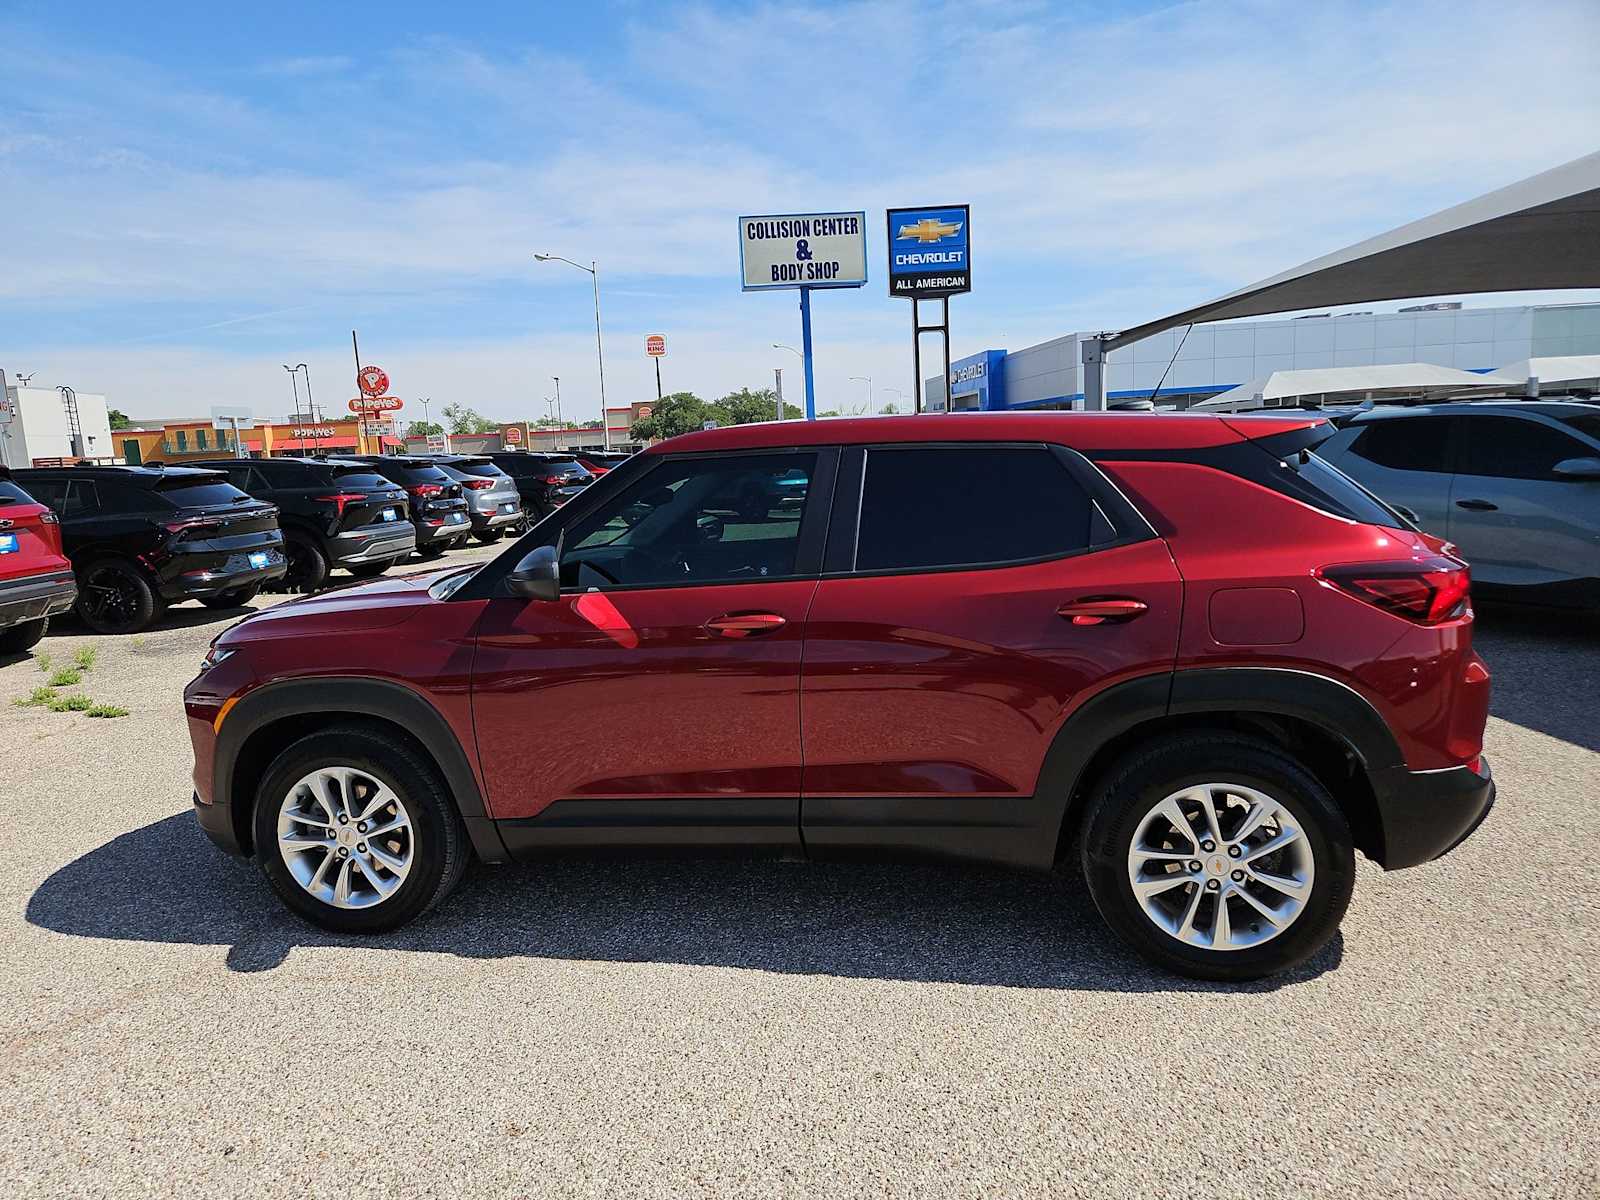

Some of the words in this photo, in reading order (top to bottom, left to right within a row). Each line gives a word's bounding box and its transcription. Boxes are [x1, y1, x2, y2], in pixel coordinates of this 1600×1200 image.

[747, 220, 810, 240] COLLISION
[813, 217, 859, 236] CENTER
[796, 239, 812, 260] &
[895, 251, 963, 265] CHEVROLET
[771, 263, 804, 281] BODY
[806, 261, 839, 280] SHOP
[895, 279, 914, 289] ALL
[915, 276, 965, 288] AMERICAN
